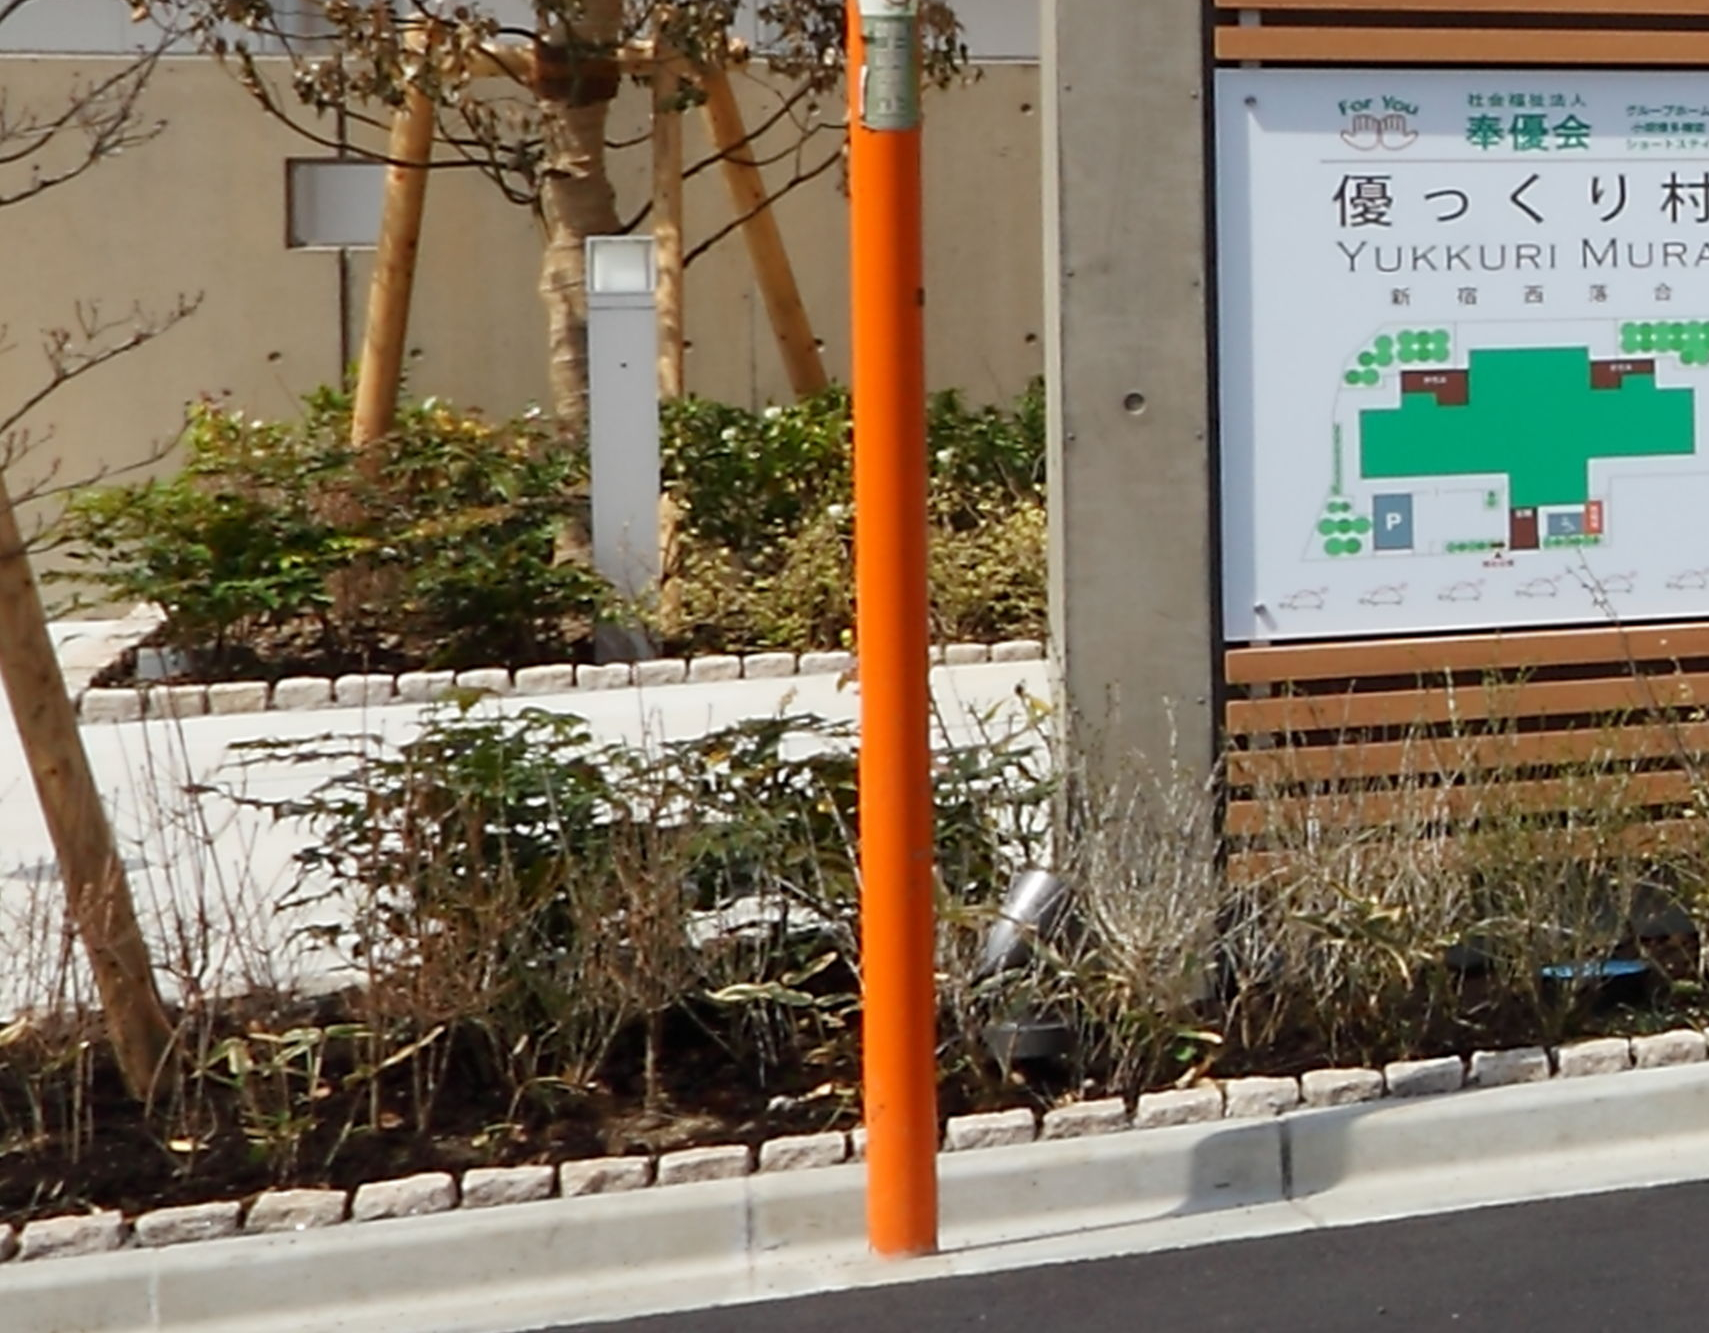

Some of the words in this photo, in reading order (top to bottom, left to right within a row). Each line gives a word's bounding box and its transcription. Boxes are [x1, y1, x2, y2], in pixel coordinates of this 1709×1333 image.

[1337, 96, 1373, 117] For
[1381, 94, 1420, 116] You
[1467, 93, 1588, 109] 社会福祉法人
[1465, 113, 1592, 151] 奉優会
[1336, 239, 1557, 273] YUKKURI
[1390, 282, 1674, 308] 新宿西落合
[1386, 512, 1402, 531] P
